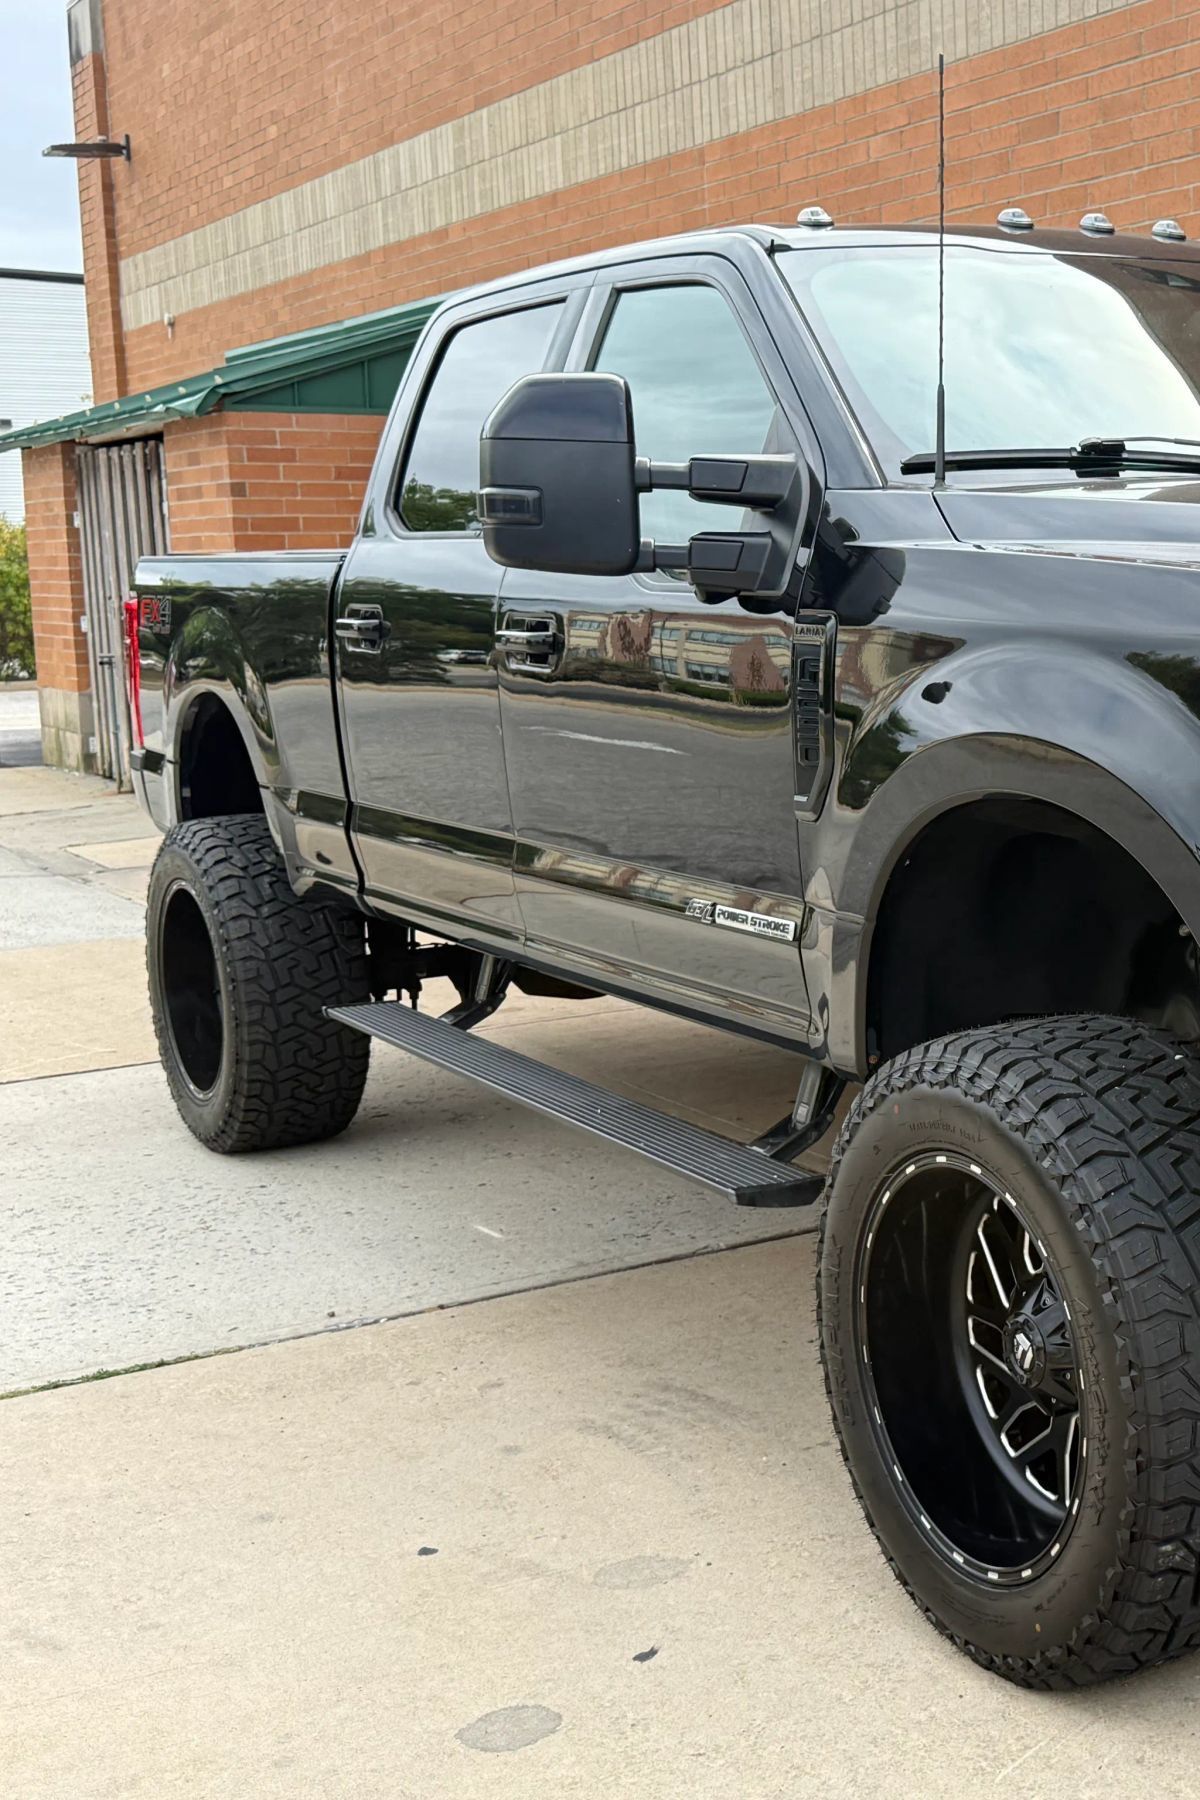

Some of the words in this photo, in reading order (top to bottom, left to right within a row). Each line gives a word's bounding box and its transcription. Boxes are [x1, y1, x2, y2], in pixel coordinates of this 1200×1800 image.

[140, 595, 172, 626] FX4
[795, 625, 825, 637] LARIAT
[716, 908, 750, 926] POWER
[749, 915, 790, 935] STROKE
